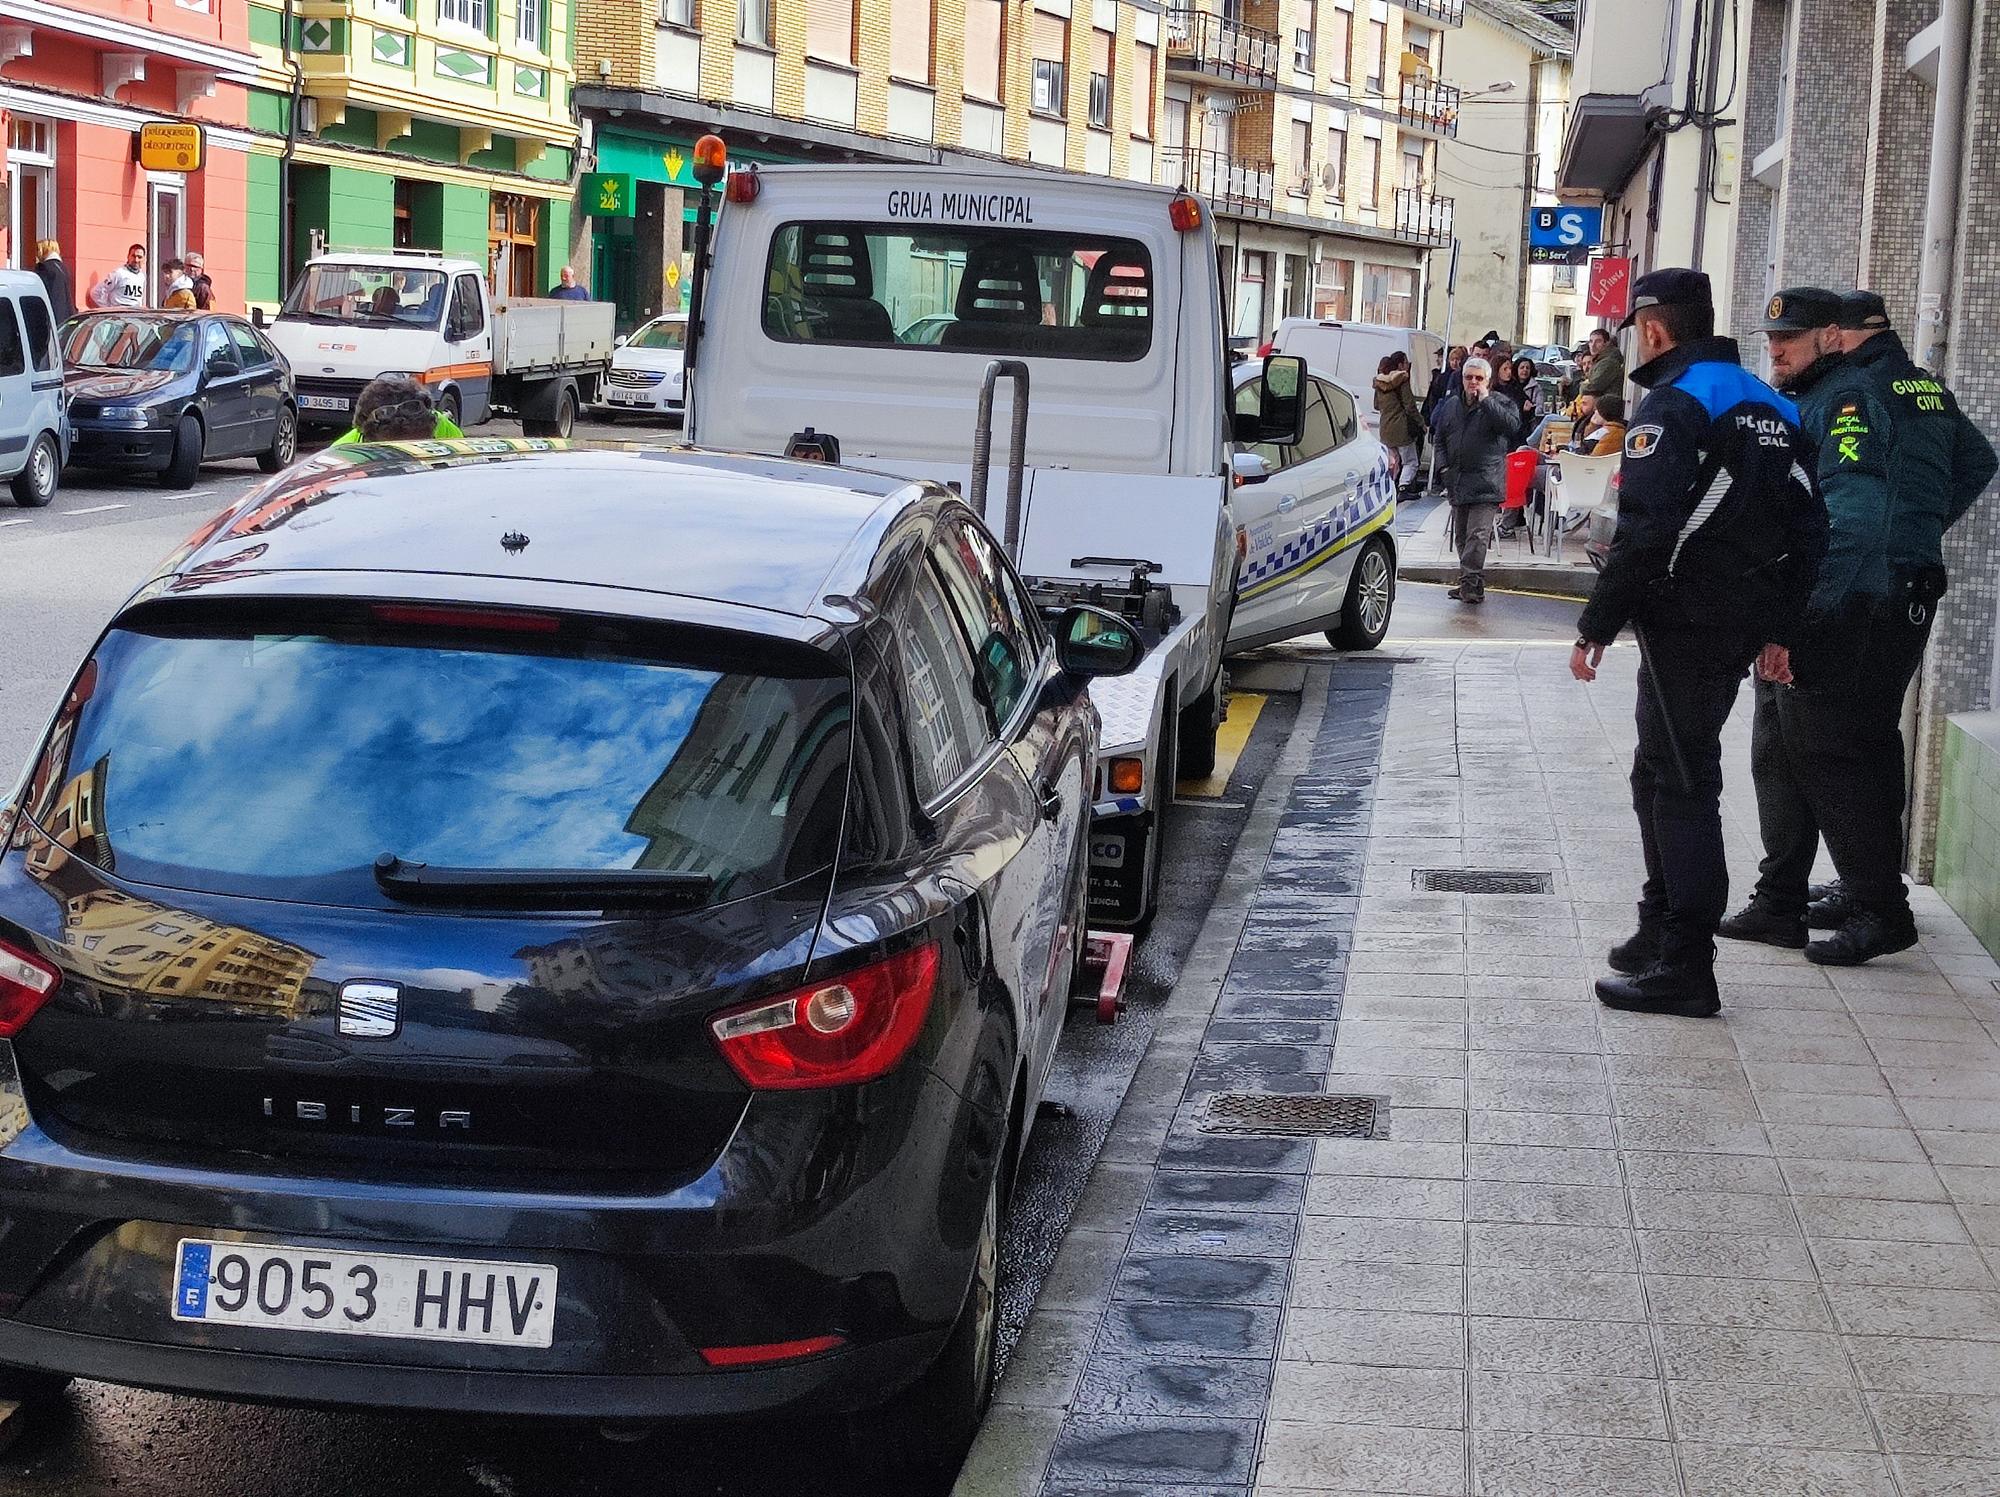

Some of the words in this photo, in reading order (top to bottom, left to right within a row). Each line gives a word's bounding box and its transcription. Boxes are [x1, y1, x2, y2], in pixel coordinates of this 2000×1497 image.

[887, 190, 932, 218] GRUA
[941, 193, 1033, 223] MUNICIPAL
[1540, 213, 1552, 227] B
[1558, 213, 1584, 245] S
[1916, 395, 1945, 411] CIVIL
[263, 1097, 471, 1128] IBIZA
[215, 1253, 378, 1323] 9053
[413, 1268, 540, 1336] HHV
